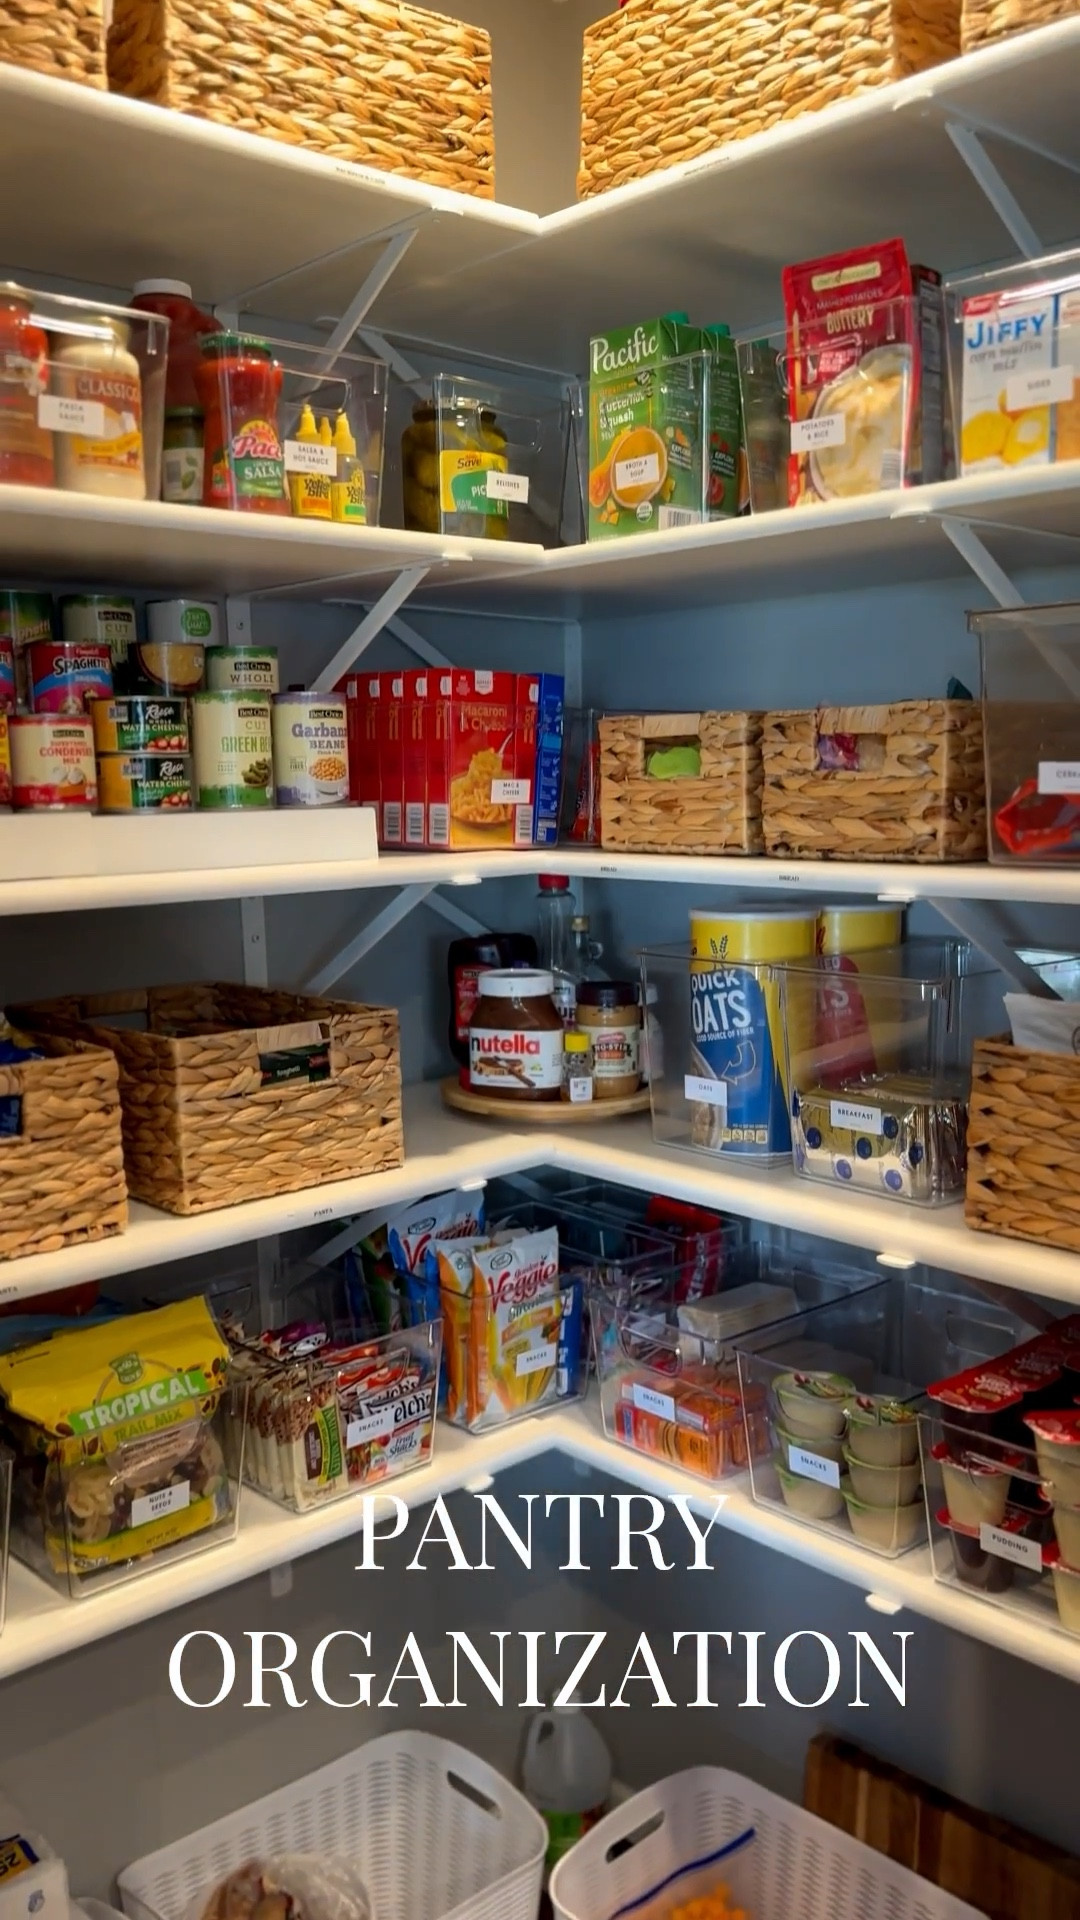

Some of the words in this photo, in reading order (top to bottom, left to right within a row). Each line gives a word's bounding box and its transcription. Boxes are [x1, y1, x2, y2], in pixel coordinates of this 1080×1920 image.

[826, 305, 875, 334] BUTTERY
[967, 314, 1048, 350] JIFFY
[590, 326, 660, 375] Pacific
[801, 419, 835, 431] POTATOES
[814, 430, 829, 439] RICE
[244, 466, 282, 480] SALSA
[309, 740, 345, 750] BEANS
[1056, 770, 1080, 779] CERE
[691, 968, 741, 995] QUICK
[691, 989, 752, 1034] OATS
[471, 1033, 540, 1055] nutella
[698, 1084, 713, 1092] OATS
[837, 1108, 874, 1121] BREAKFAST
[488, 1262, 557, 1315] Veggie
[79, 1374, 200, 1430] TROPICAL
[800, 1456, 827, 1472] SNACKS
[149, 1492, 166, 1503] NUTS
[151, 1499, 171, 1511] SEEDS
[991, 1532, 1029, 1554] PUDDING
